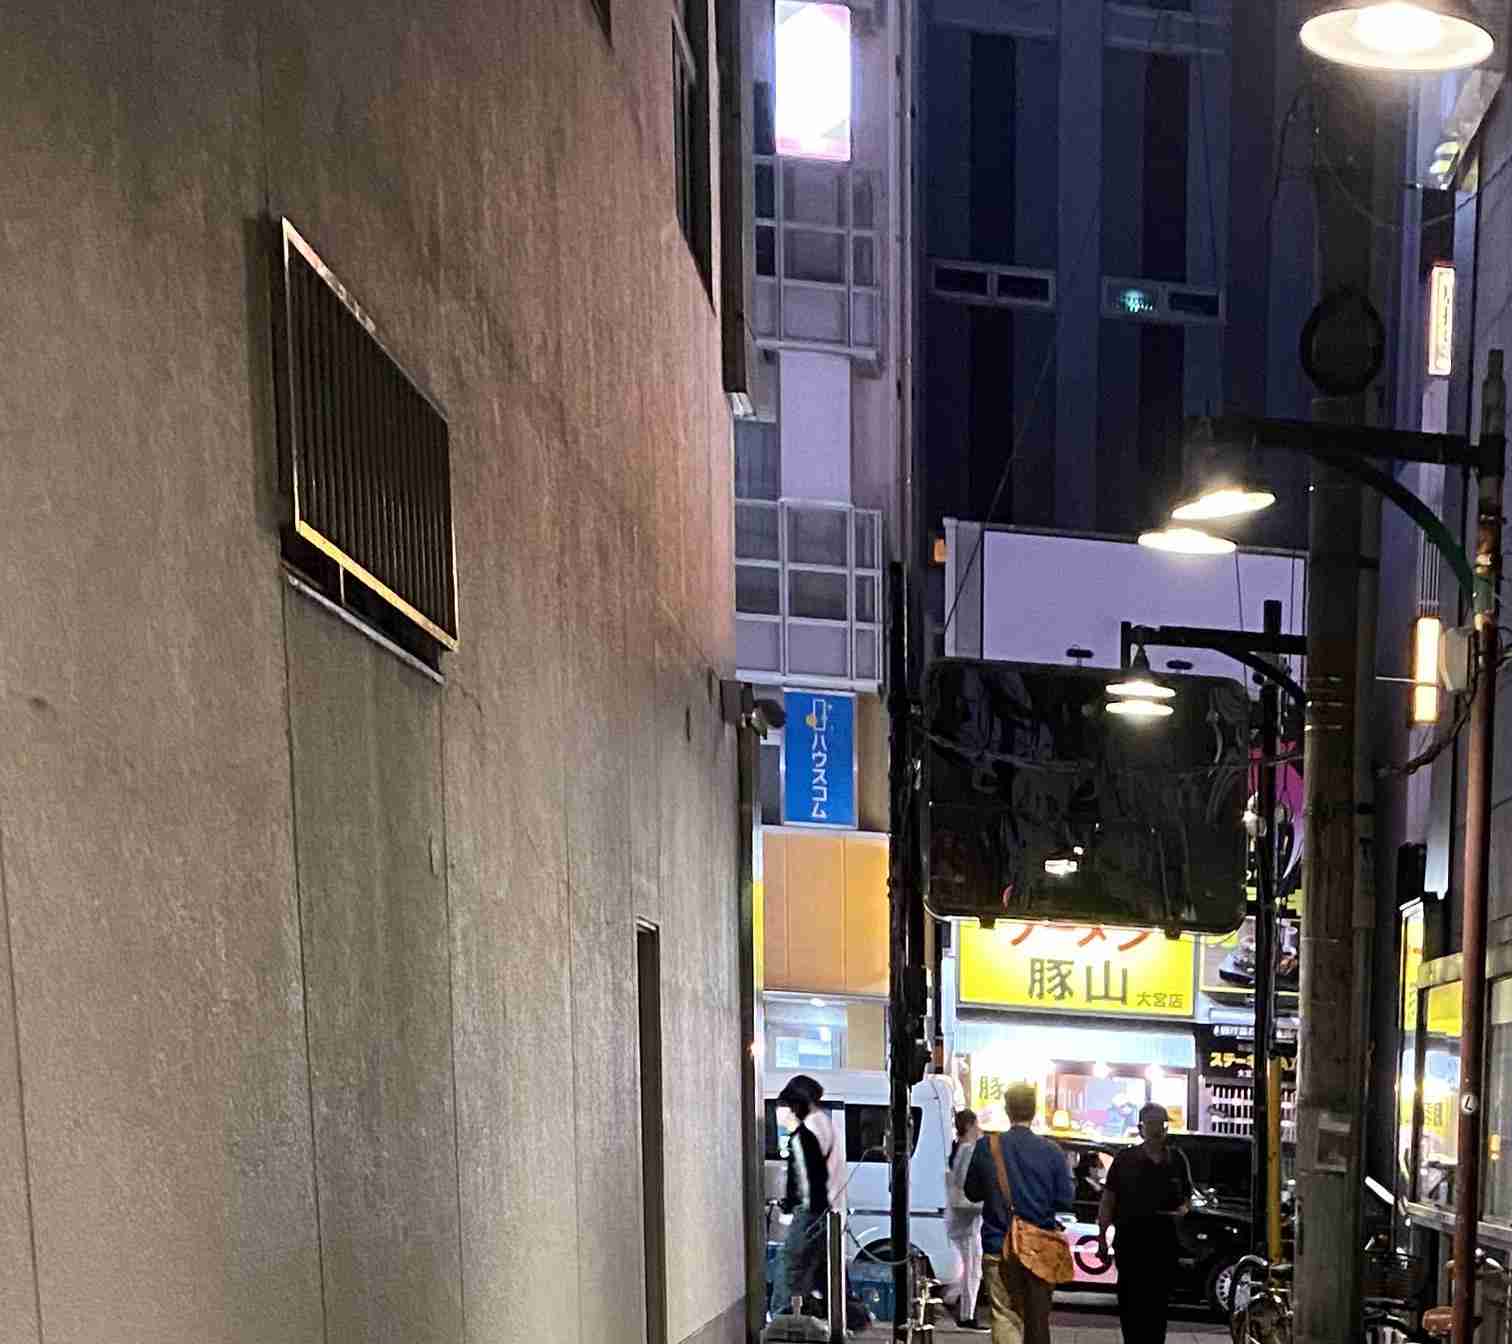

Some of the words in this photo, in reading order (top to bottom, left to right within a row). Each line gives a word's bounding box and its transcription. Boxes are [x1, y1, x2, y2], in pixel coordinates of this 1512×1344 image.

[811, 733, 828, 819] ハウスコム
[1028, 957, 1128, 1006] 豚山
[1136, 991, 1184, 1009] 大宮店
